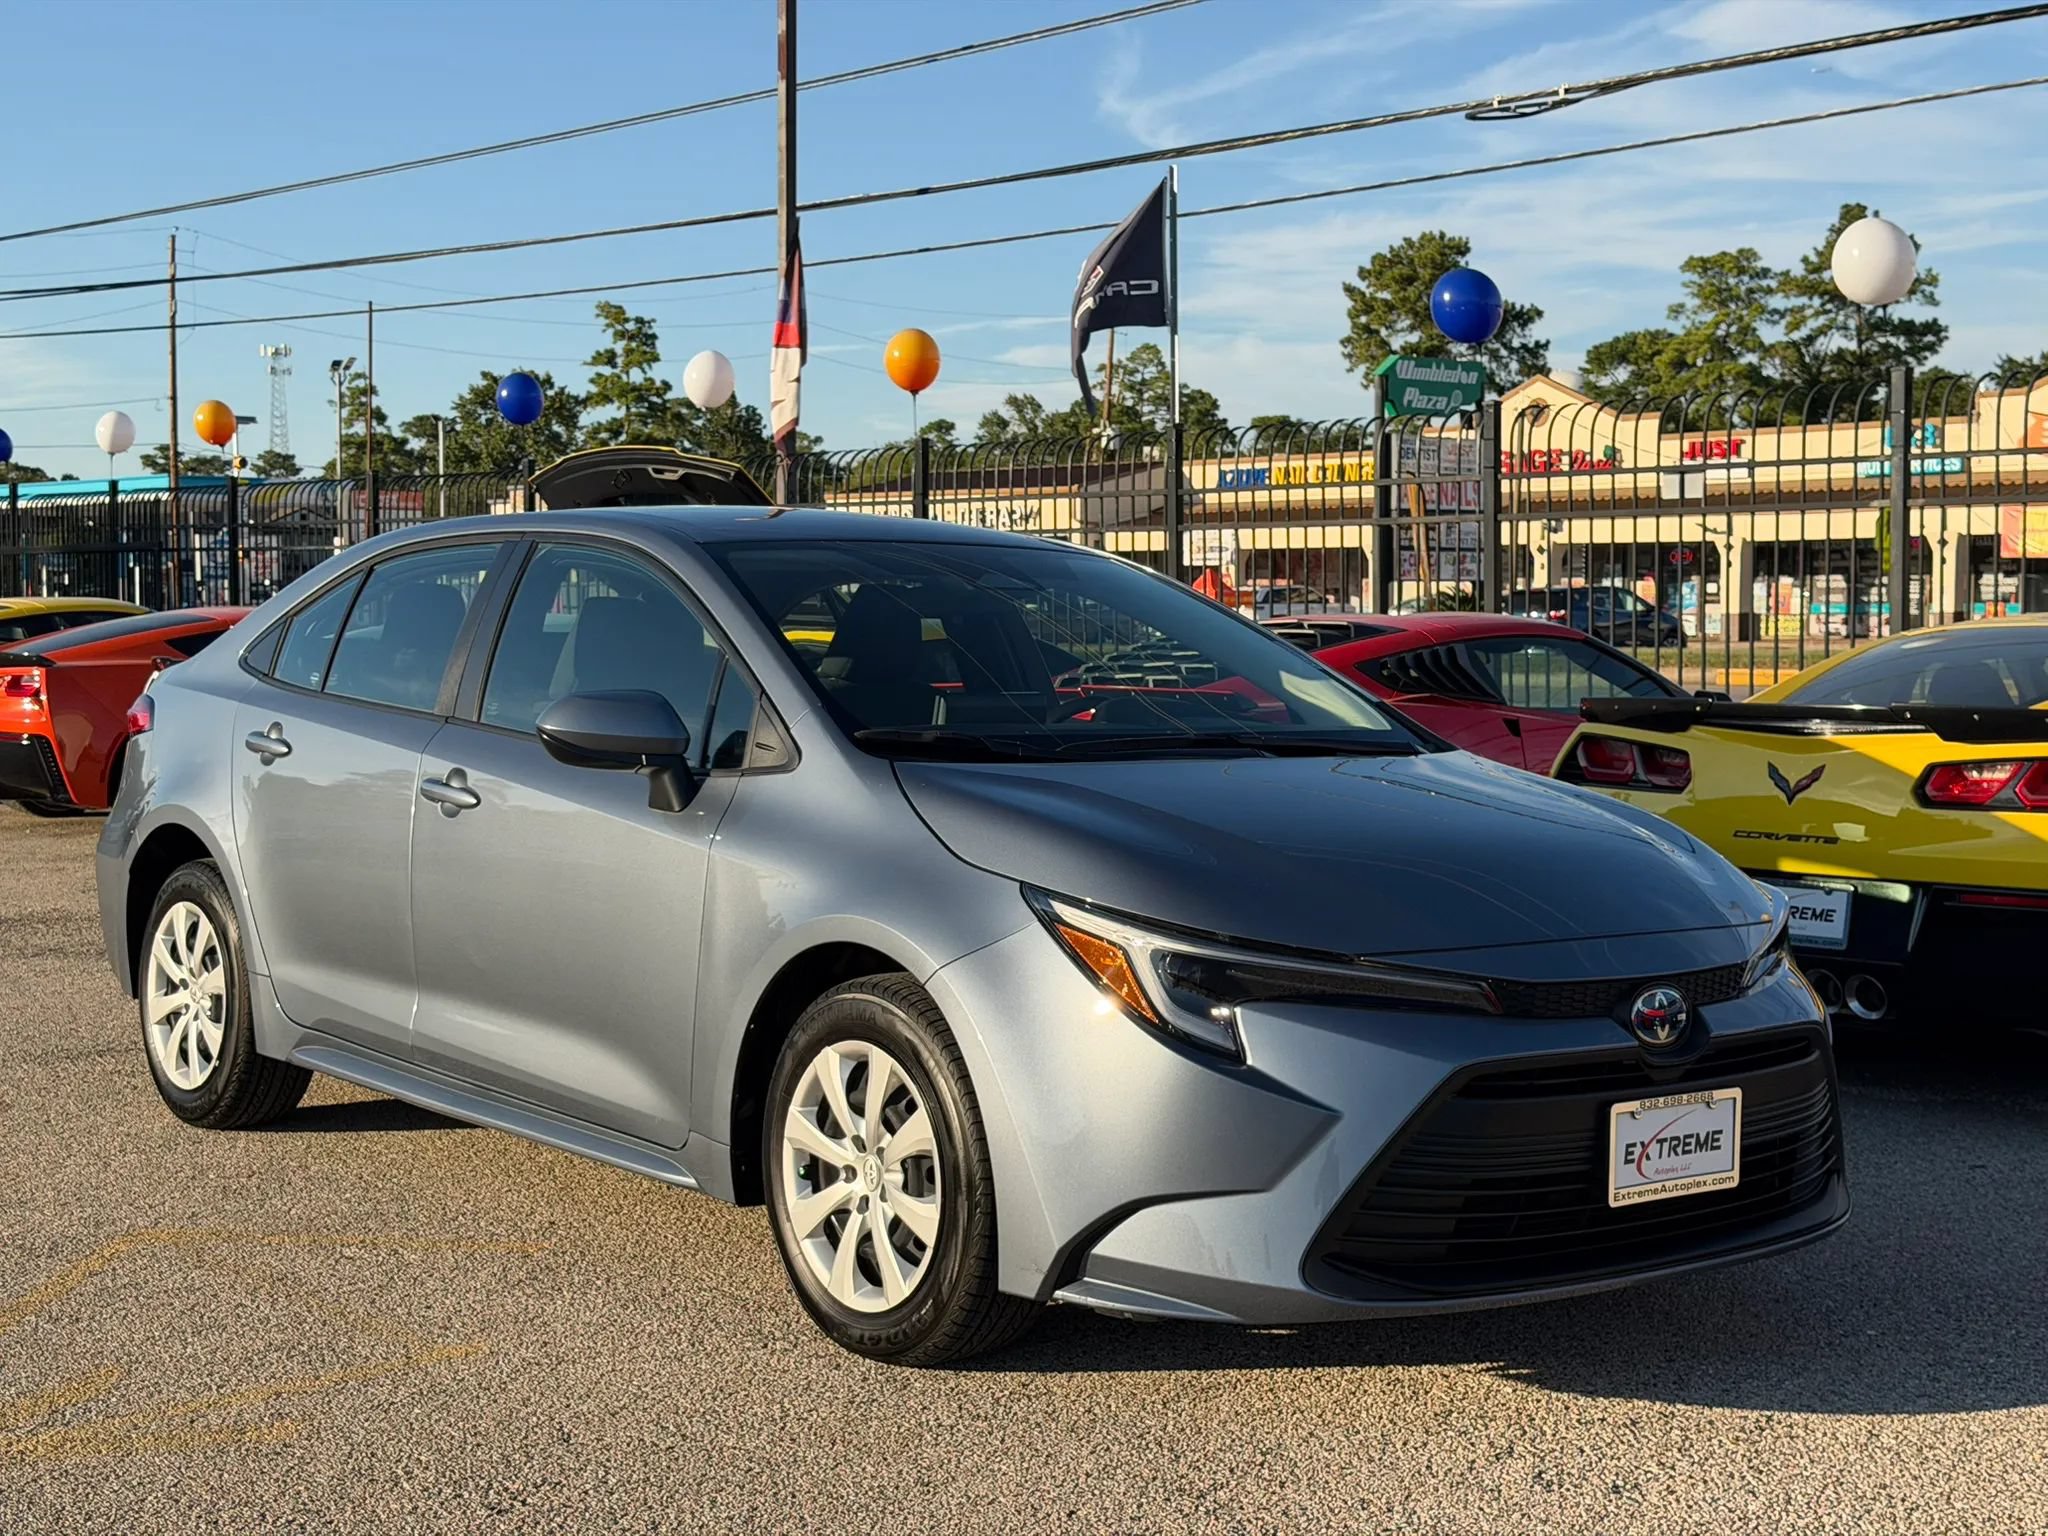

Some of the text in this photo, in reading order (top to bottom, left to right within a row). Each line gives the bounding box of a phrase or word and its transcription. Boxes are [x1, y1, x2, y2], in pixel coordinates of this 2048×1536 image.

[1396, 360, 1479, 385] Wimbledon
[1403, 387, 1448, 410] Plaza
[1400, 446, 1437, 461] DENIST
[1684, 438, 1745, 461] JUST
[1440, 481, 1481, 507] NALS
[1733, 830, 1840, 845] CORVETTE
[1623, 1129, 1724, 1165] EXTREME
[1613, 1175, 1735, 1202] ExtremeAutoplex.com
